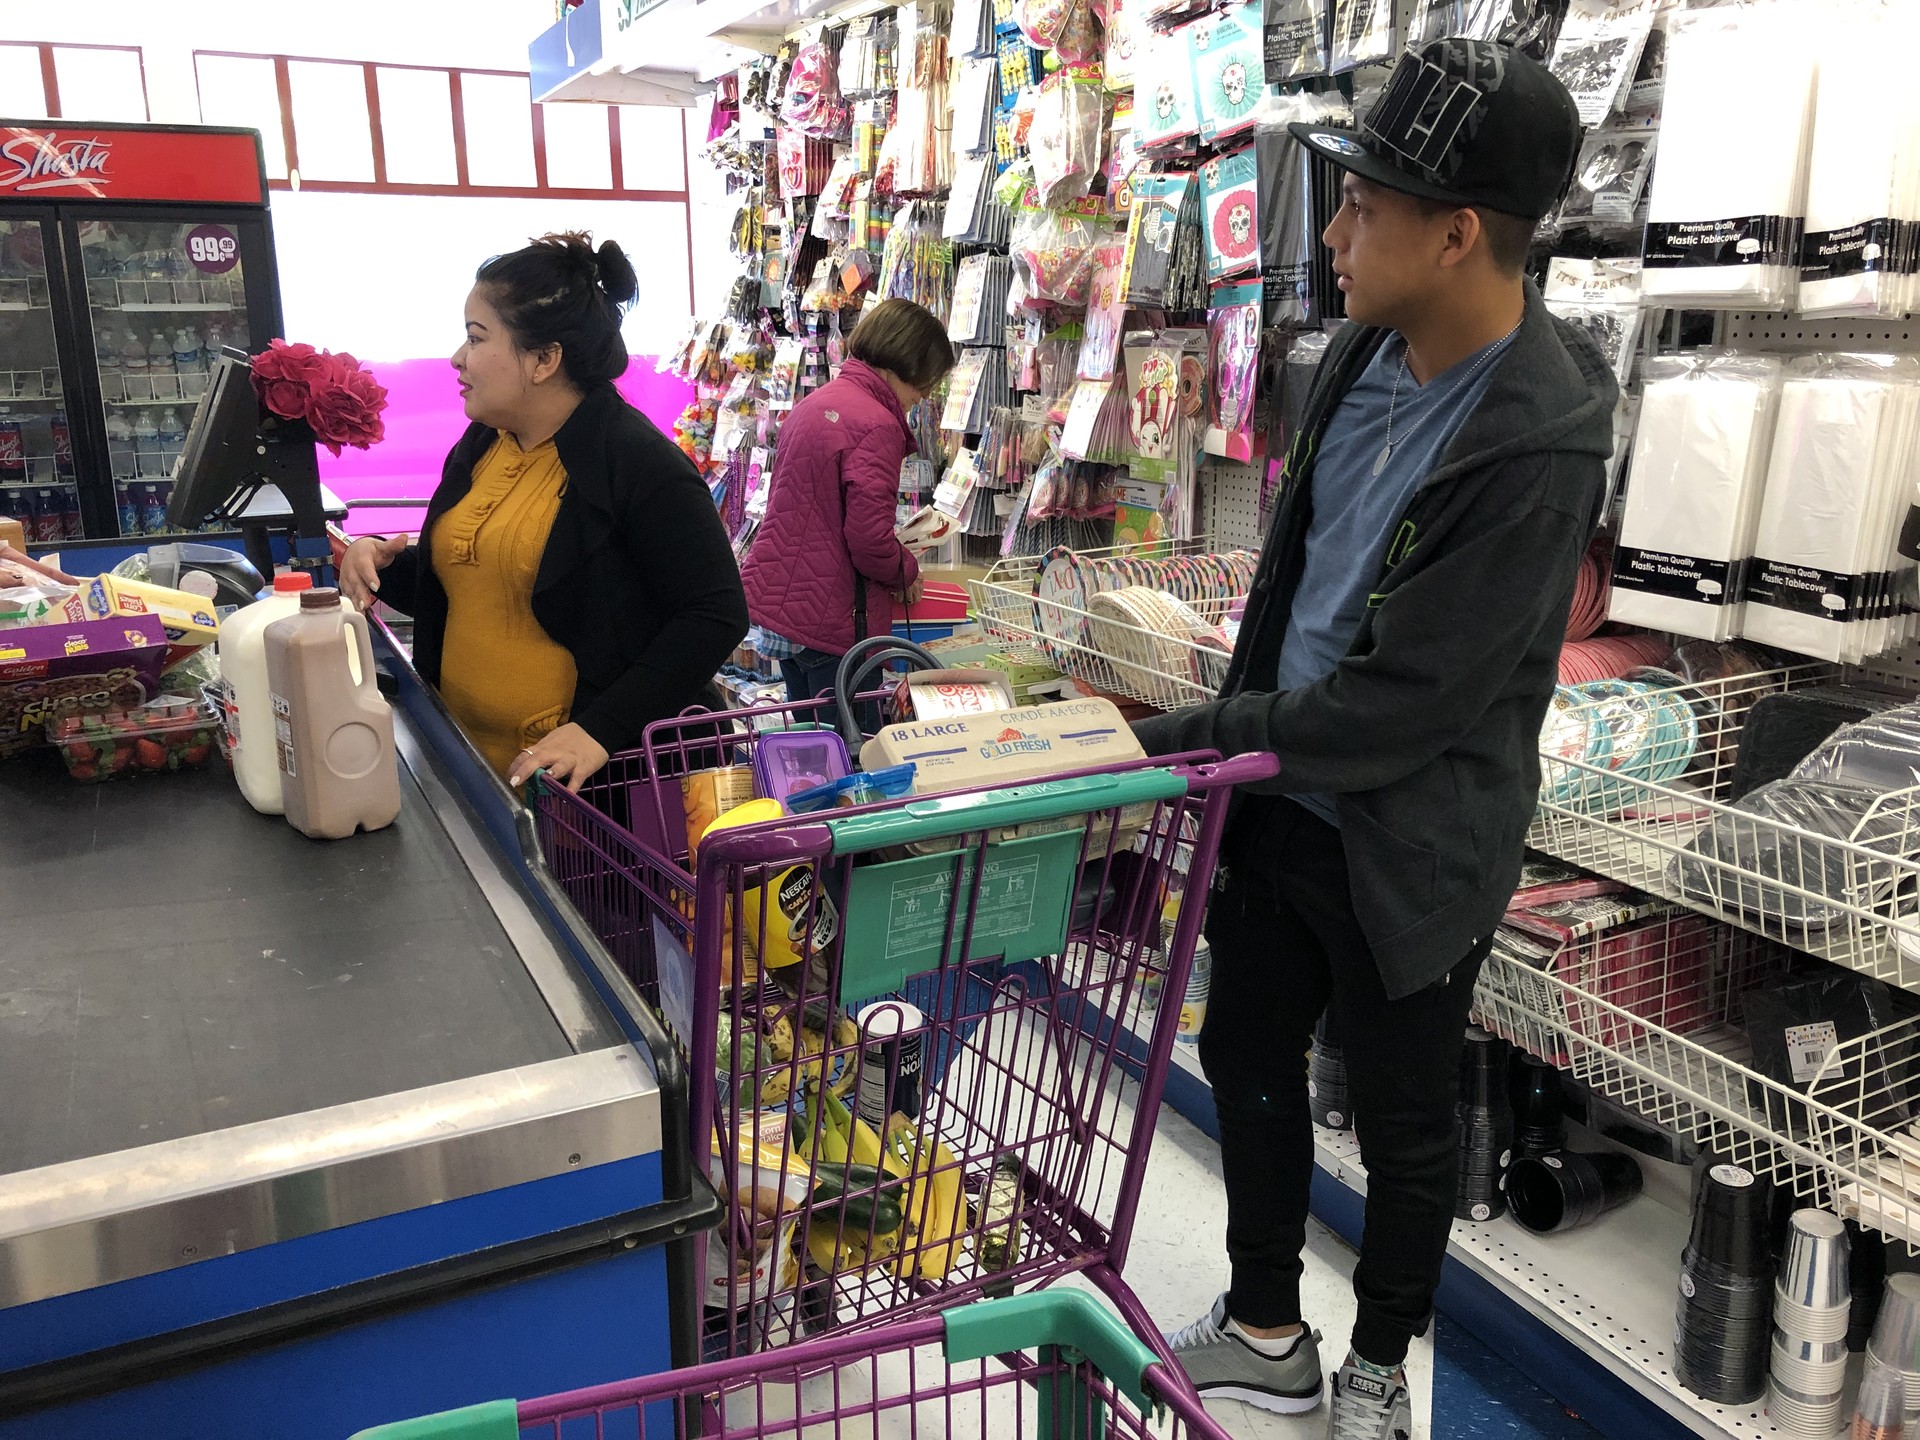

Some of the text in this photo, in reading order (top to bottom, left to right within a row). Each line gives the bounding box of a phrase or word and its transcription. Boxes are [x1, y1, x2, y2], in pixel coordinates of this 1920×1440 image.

[1267, 31, 1289, 43] Plastic
[0, 131, 115, 188] Shasta
[1678, 220, 1736, 233] Premium Quality
[1667, 233, 1741, 245] Plastic Tablecover
[1828, 230, 1851, 242] Premium
[1818, 239, 1867, 256] Plastic Tablecover
[1262, 274, 1282, 283] lastic
[1640, 551, 1695, 568] Premium Quality
[1631, 560, 1656, 572] Plastic
[1657, 564, 1702, 580] Tablecover
[1768, 562, 1797, 576] Premium
[1797, 568, 1822, 581] Quality
[1761, 572, 1784, 585] Plastic
[1785, 577, 1827, 594] Tablecover
[1000, 710, 1047, 725] GRADE
[890, 722, 970, 743] 18 LARGE
[979, 738, 1053, 760] GOLD FRESH
[900, 1050, 918, 1065] SALT
[1352, 1375, 1383, 1392] RBX
